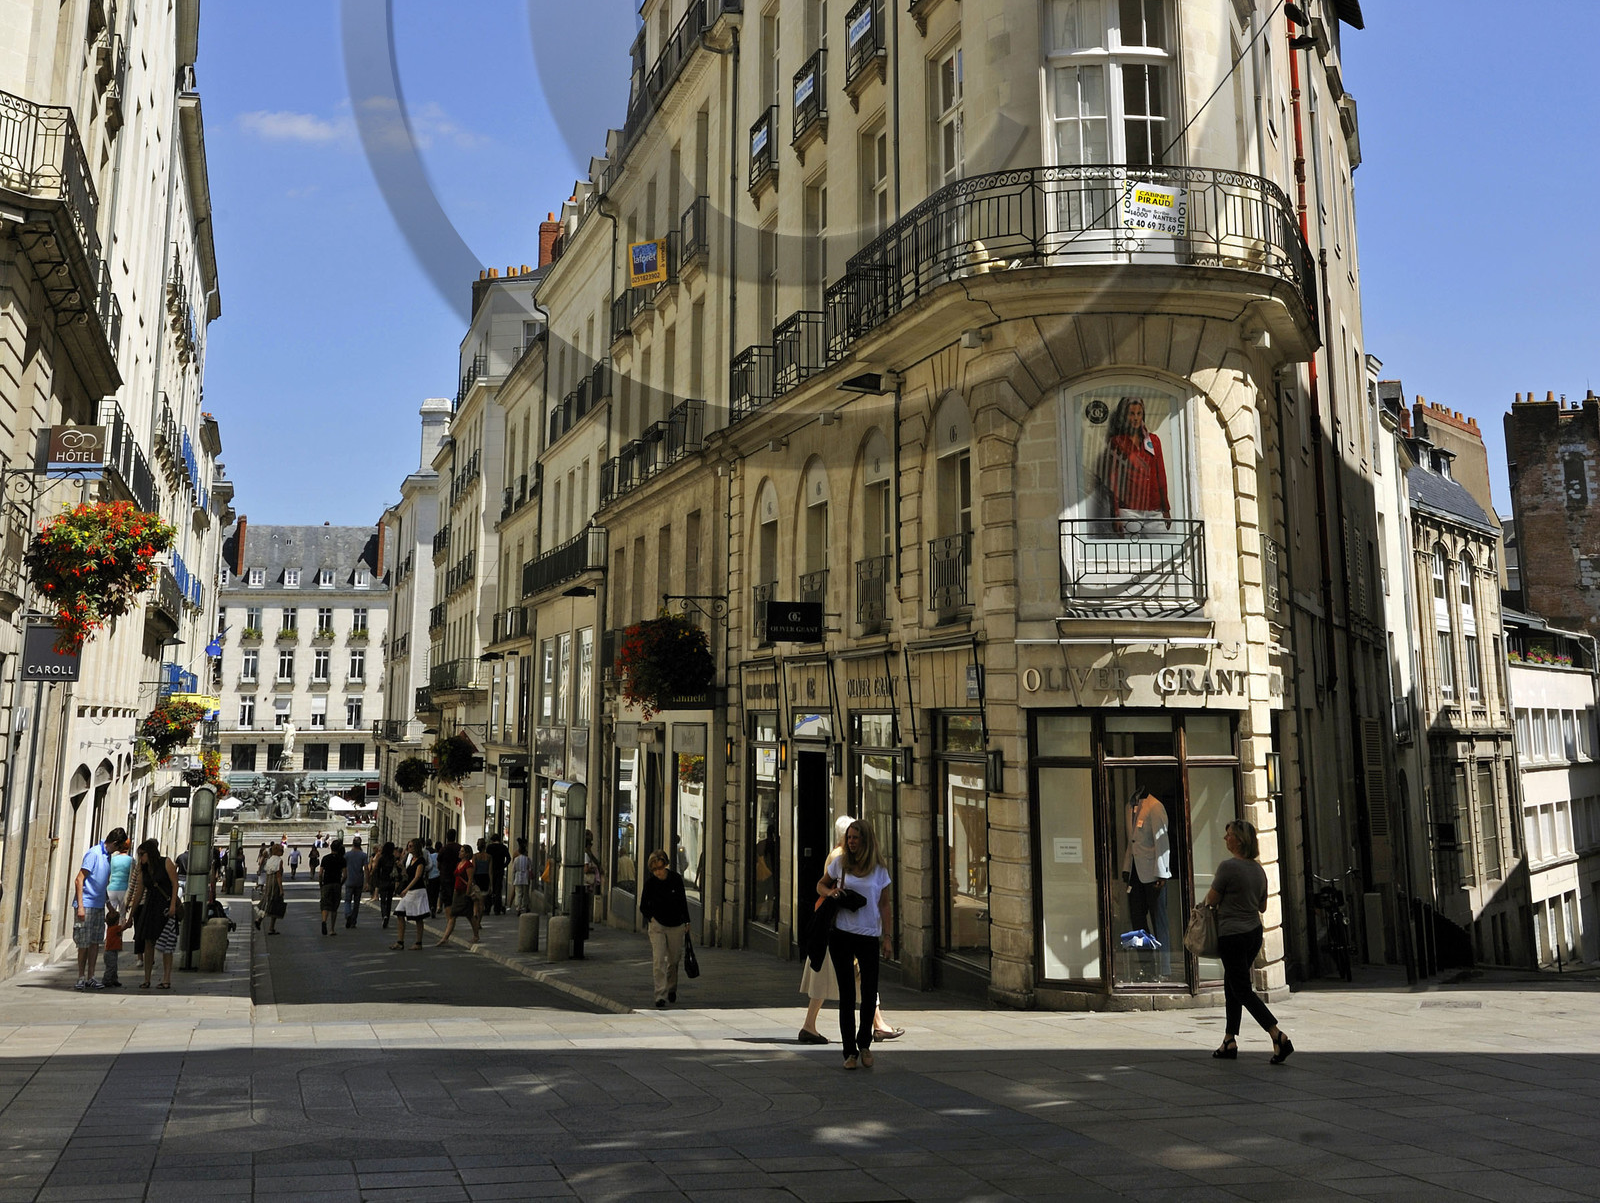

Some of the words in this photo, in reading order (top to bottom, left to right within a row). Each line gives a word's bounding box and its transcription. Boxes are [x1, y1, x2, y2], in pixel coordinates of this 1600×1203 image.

[1139, 191, 1169, 199] CABINET
[1138, 196, 1171, 207] PIRAUD
[1153, 214, 1177, 223] NANTES
[1177, 202, 1186, 235] LOUER
[1148, 221, 1156, 229] 69
[1158, 223, 1165, 231] 75
[1168, 225, 1176, 233] 69
[56, 449, 96, 462] HÔTEL
[27, 665, 74, 674] CAROLL
[1022, 667, 1133, 692] OLIVER
[1157, 667, 1249, 696] GRANT
[847, 678, 870, 697] OLIVER
[672, 693, 706, 703] anfield
